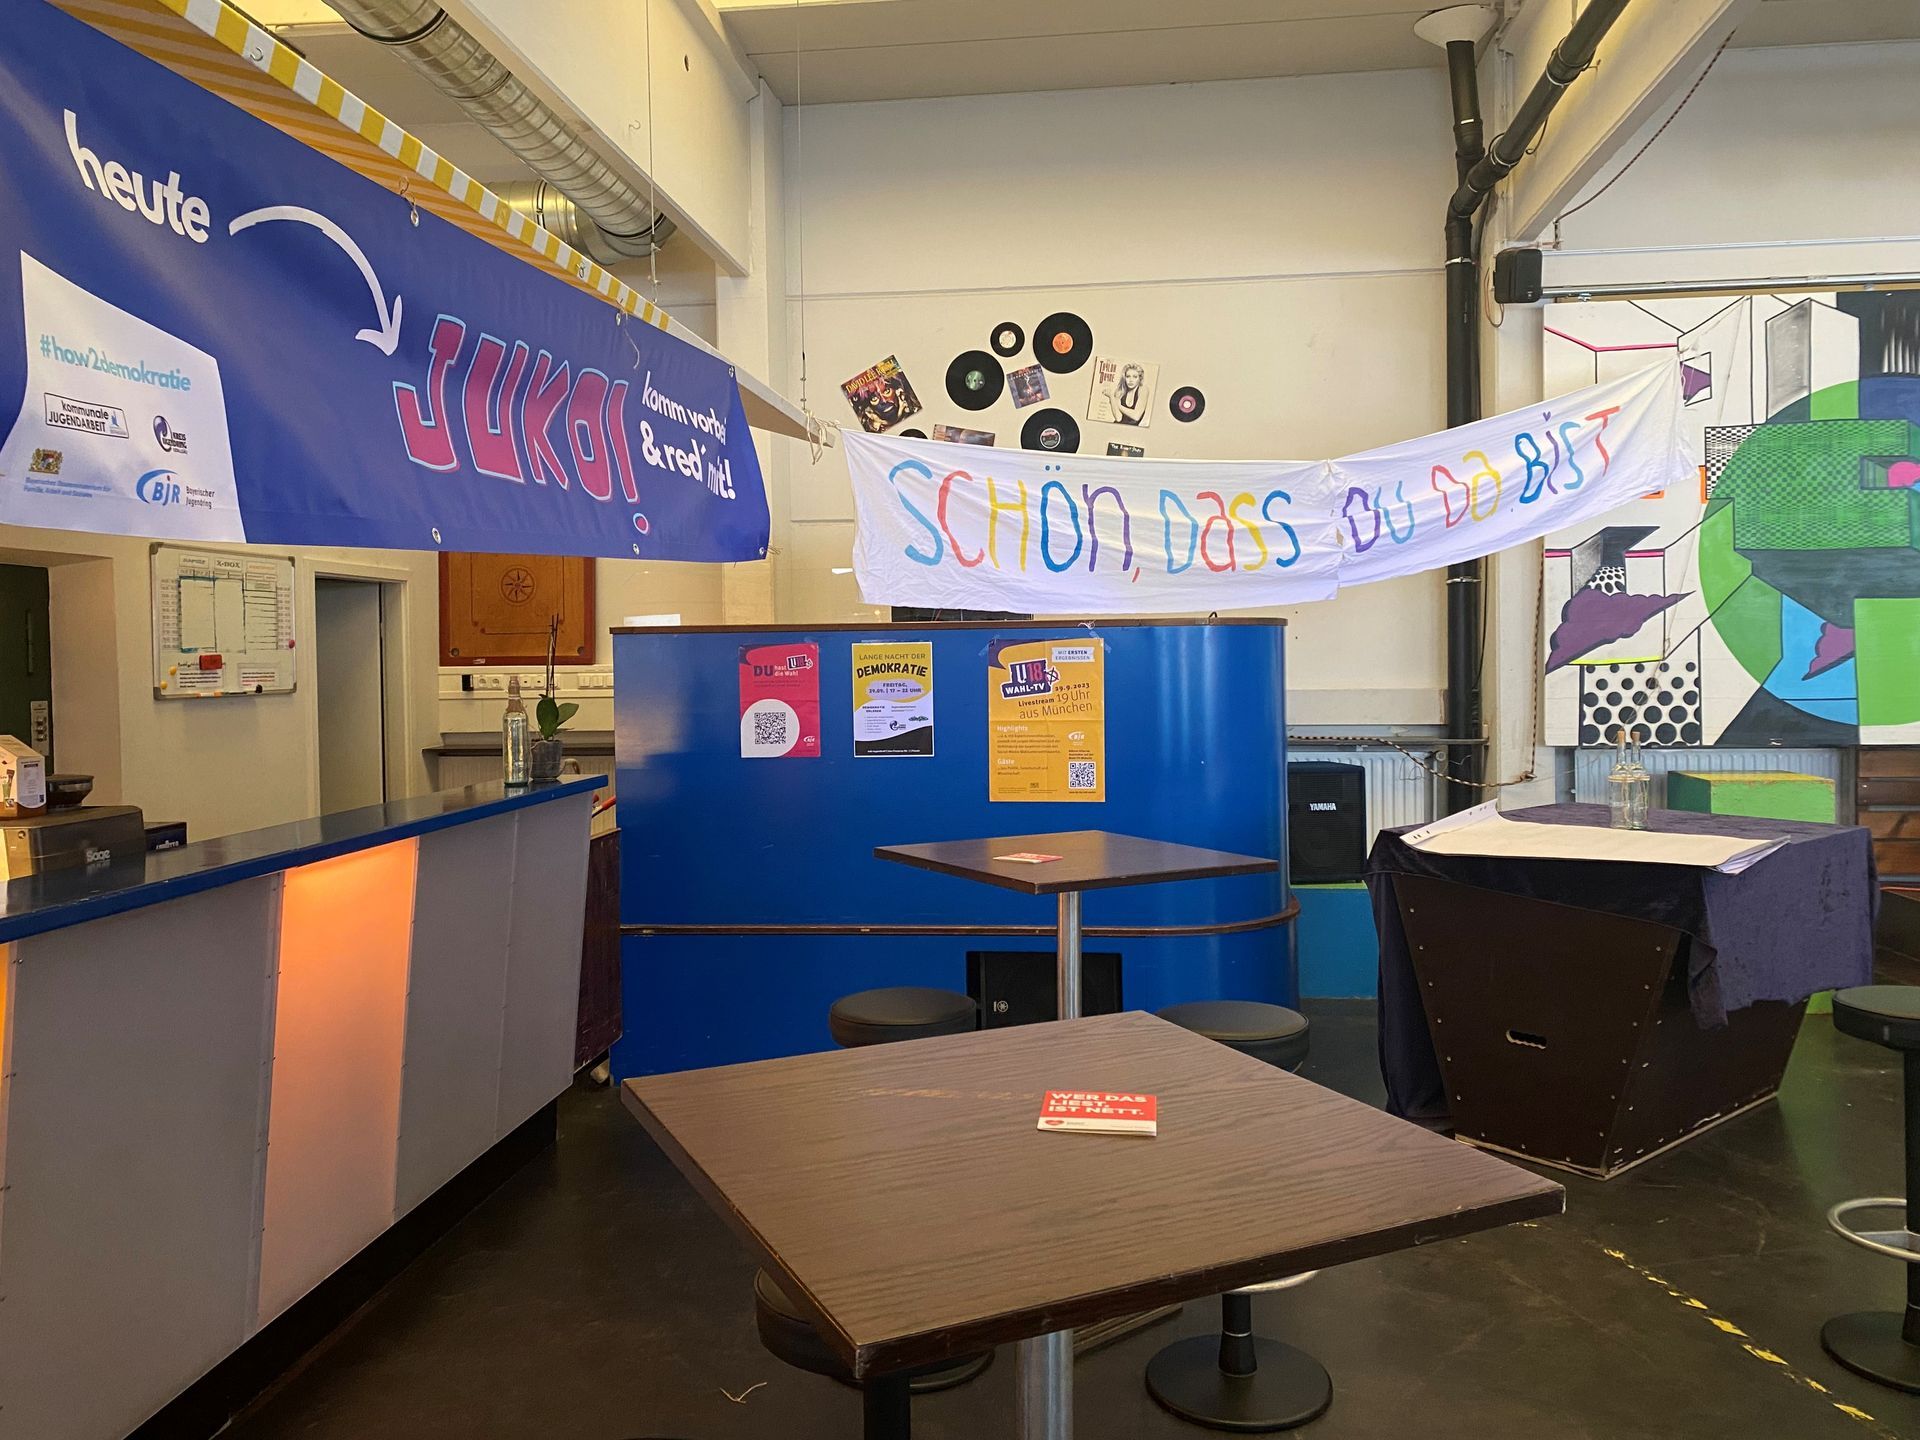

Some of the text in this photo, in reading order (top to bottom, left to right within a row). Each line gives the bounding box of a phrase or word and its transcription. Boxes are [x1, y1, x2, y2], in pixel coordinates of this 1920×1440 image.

[63, 108, 210, 243] heute
[39, 334, 192, 391] #how2demokratie
[642, 370, 688, 425] komm
[61, 400, 109, 420] kommunale
[48, 411, 106, 433] JUGENDARBEIT
[392, 313, 650, 535] JUKO!
[640, 420, 667, 469] &
[707, 455, 737, 500] mit!
[185, 486, 215, 498] Bayerischer
[185, 497, 212, 510] Jugendring
[753, 665, 774, 677] DU
[856, 662, 928, 679] DEMOKRATIE
[1015, 662, 1043, 684] U18
[1005, 683, 1045, 695] WAHL-TV
[1018, 690, 1090, 707] Livestream 19 Uhr
[1020, 710, 1039, 719] aus
[1309, 803, 1336, 811] YAMAHA
[1085, 1106, 1144, 1115] NETT.
